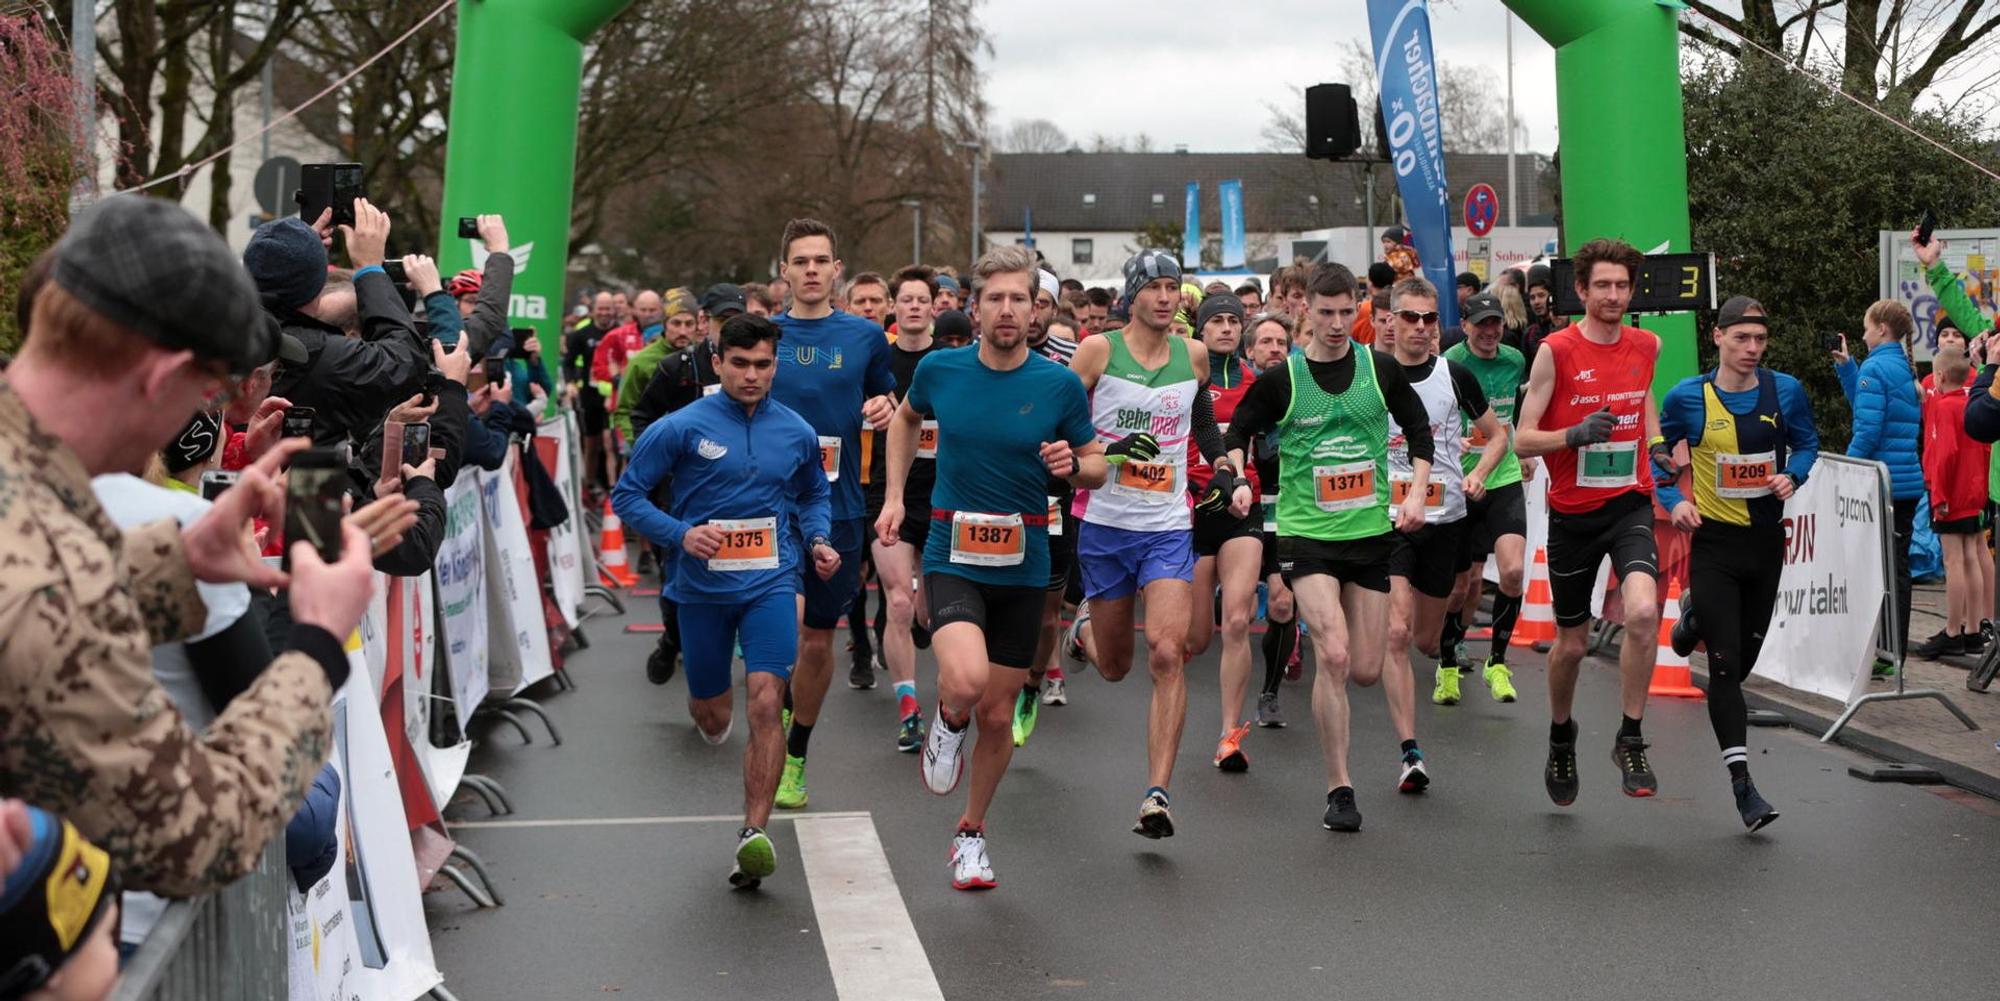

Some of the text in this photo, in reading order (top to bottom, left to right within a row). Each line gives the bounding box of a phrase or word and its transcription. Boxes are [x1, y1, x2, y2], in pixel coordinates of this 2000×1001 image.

[1495, 250, 1524, 261] Sohn
[1679, 266, 1699, 298] 3
[1116, 407, 1180, 436] sebamed
[1606, 453, 1614, 467] 1
[1130, 464, 1166, 481] 1402
[1730, 464, 1766, 479] 1209
[1328, 474, 1364, 491] 1371
[1400, 482, 1435, 497] 13
[724, 531, 764, 548] 1375
[968, 526, 1013, 543] 1387
[1809, 572, 1849, 615] talent
